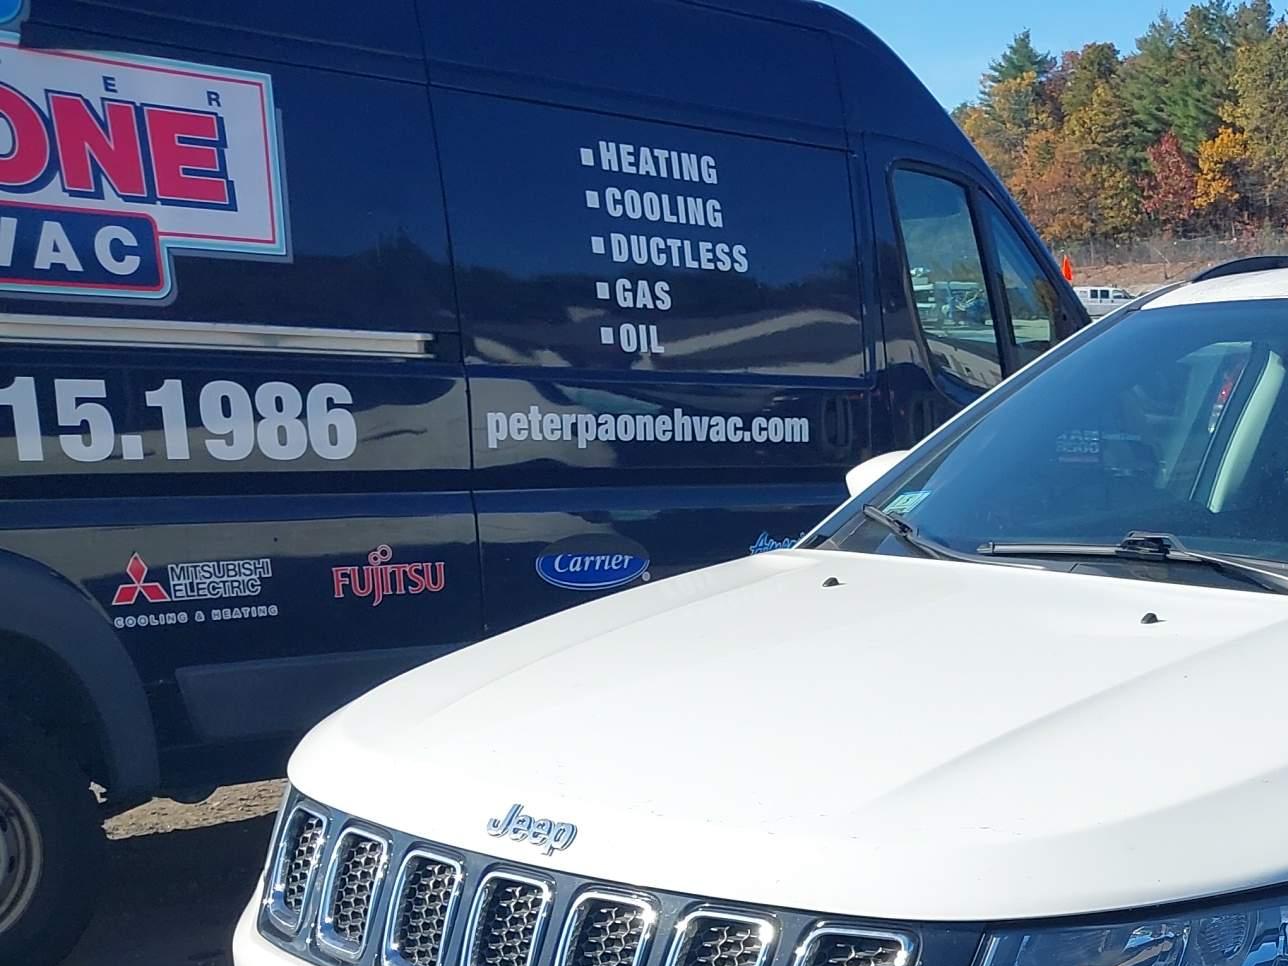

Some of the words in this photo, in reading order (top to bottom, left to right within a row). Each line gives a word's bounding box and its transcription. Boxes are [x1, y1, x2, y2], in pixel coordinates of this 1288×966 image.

[599, 141, 718, 185] HEATING
[605, 187, 723, 228] COOLING
[610, 233, 749, 273] DUCTLESS
[615, 278, 672, 311] GAS
[619, 323, 665, 354] OIL
[0, 376, 357, 462] 15.1986
[487, 405, 810, 449] peterpaonehvac.com
[167, 558, 273, 583] MITSUBISHI
[553, 552, 635, 573] Carrier
[170, 580, 262, 602] ELECTRIC
[332, 560, 445, 607] FUJITSU
[114, 612, 188, 629] COOLING
[196, 611, 205, 622] &
[212, 605, 279, 621] HEATING
[486, 803, 578, 857] Jeep
